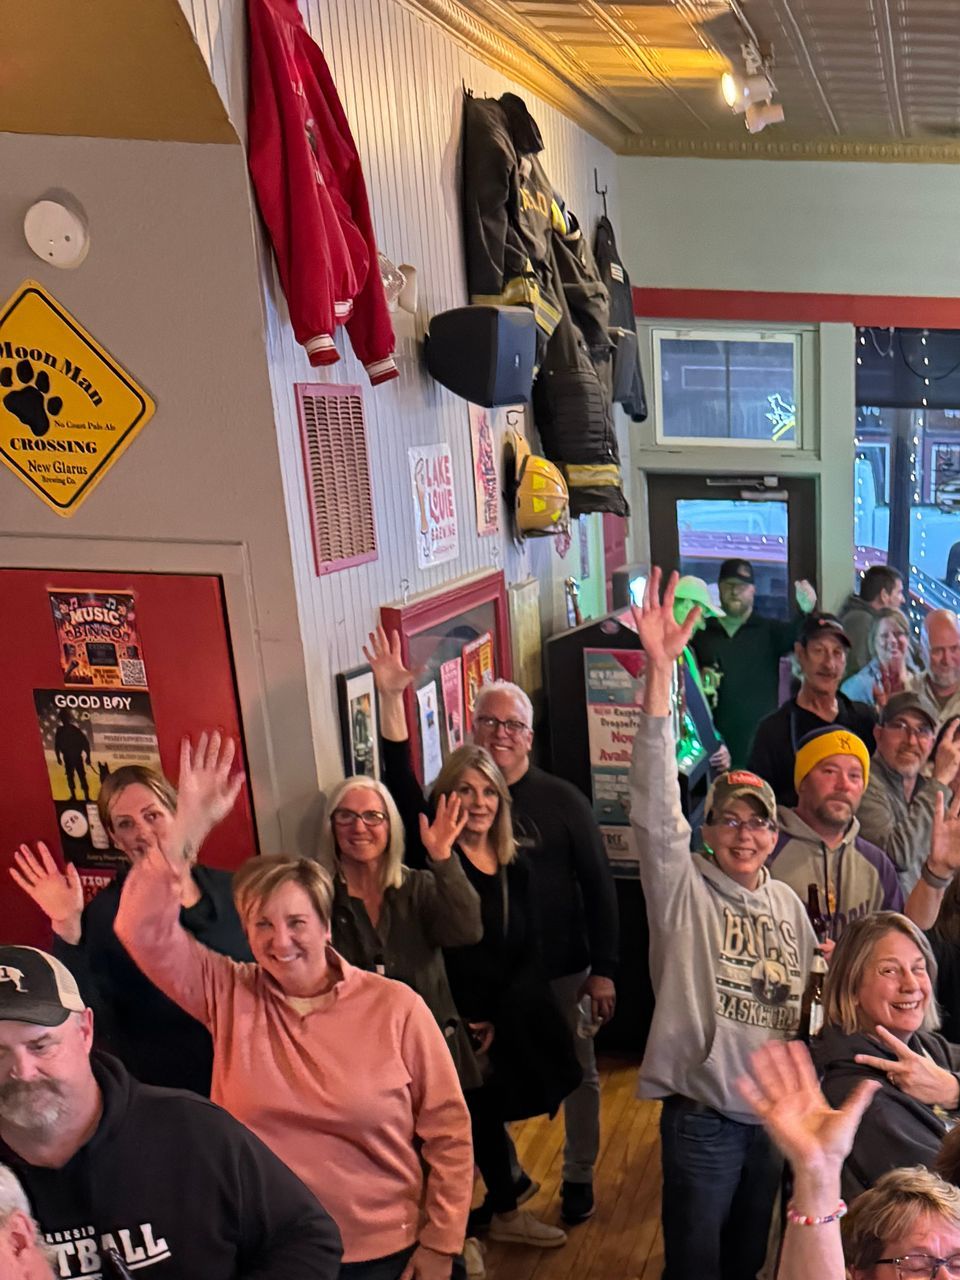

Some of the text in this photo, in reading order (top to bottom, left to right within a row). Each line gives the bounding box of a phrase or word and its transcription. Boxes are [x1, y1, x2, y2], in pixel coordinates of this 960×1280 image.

[60, 357, 103, 407] Man
[9, 437, 98, 454] CROSSING
[28, 459, 88, 475] New Glarus
[425, 455, 451, 487] LAKE
[429, 489, 455, 524] LOUIE
[69, 606, 120, 625] MUSIC
[74, 624, 121, 639] BINGO
[54, 694, 132, 711] GOOD BOY
[44, 1225, 96, 1244] ARKSID
